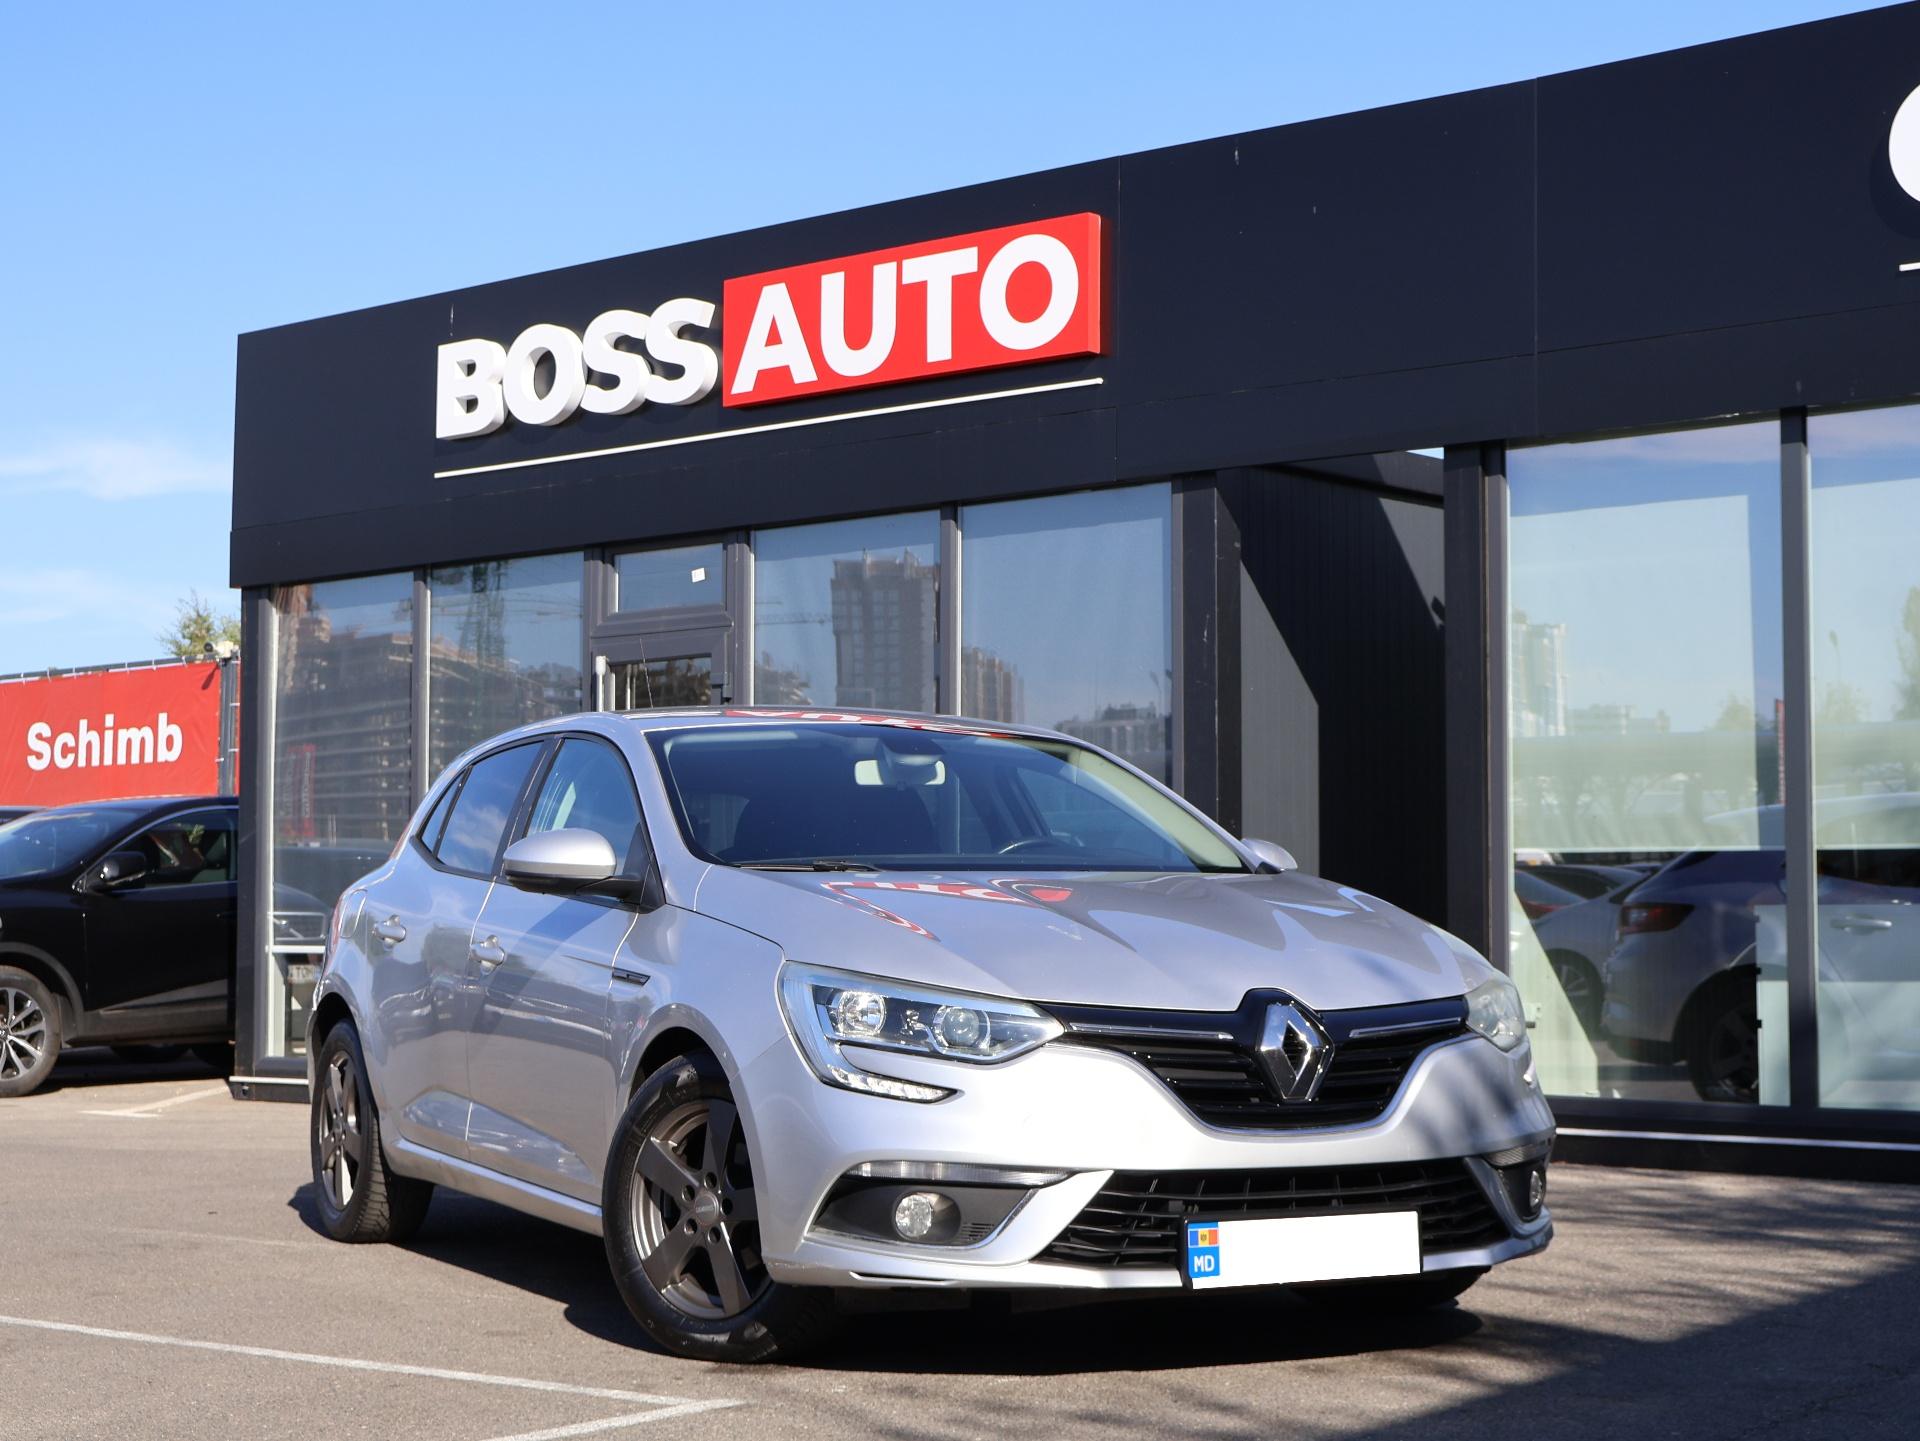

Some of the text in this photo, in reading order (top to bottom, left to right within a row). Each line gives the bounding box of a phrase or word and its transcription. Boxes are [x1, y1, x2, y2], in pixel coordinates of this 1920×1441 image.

[435, 233, 1078, 439] BOSS AUTO
[26, 712, 183, 771] Schimb
[1193, 1254, 1215, 1273] MD
